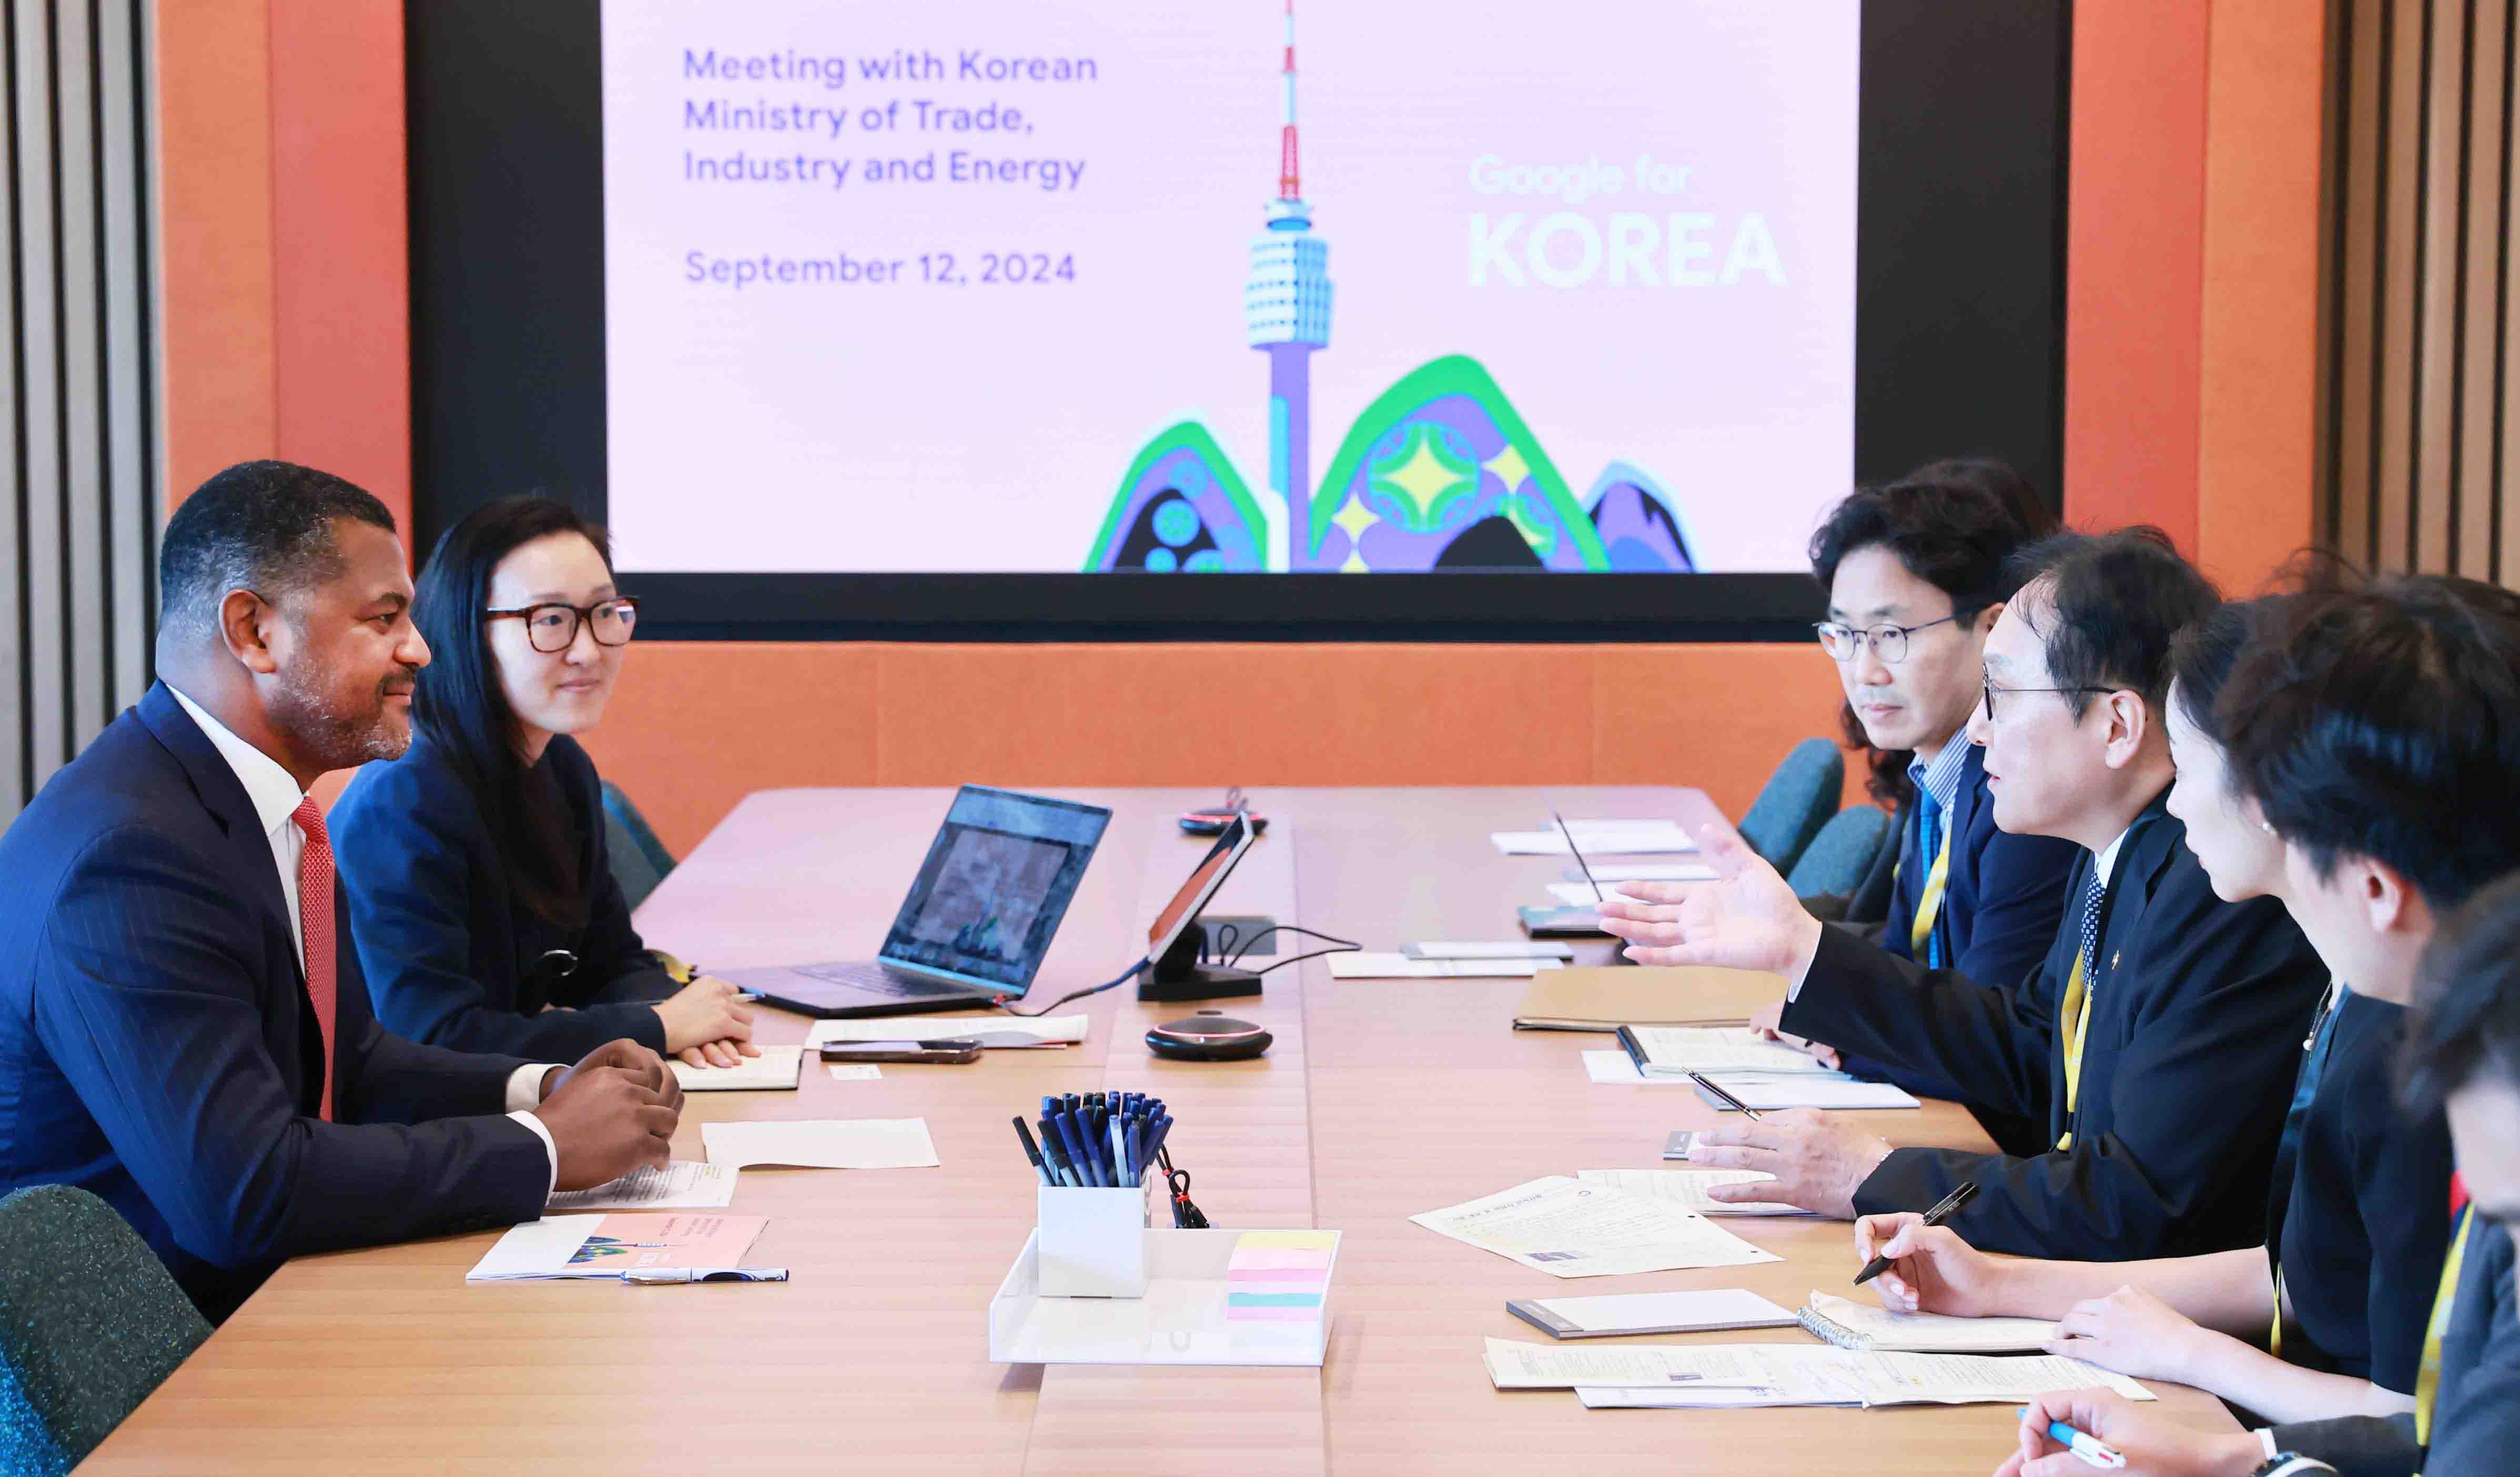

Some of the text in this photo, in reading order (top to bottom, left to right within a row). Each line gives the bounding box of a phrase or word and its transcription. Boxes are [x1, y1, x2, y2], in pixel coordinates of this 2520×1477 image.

[684, 49, 1098, 89] Meeting with Korean
[685, 99, 1034, 139] Ministry of Trade,
[685, 150, 1086, 191] Industry and Energy
[1468, 153, 1692, 204] Google for
[1468, 212, 1786, 287] KOREA
[685, 251, 1076, 289] September 12, 2024
